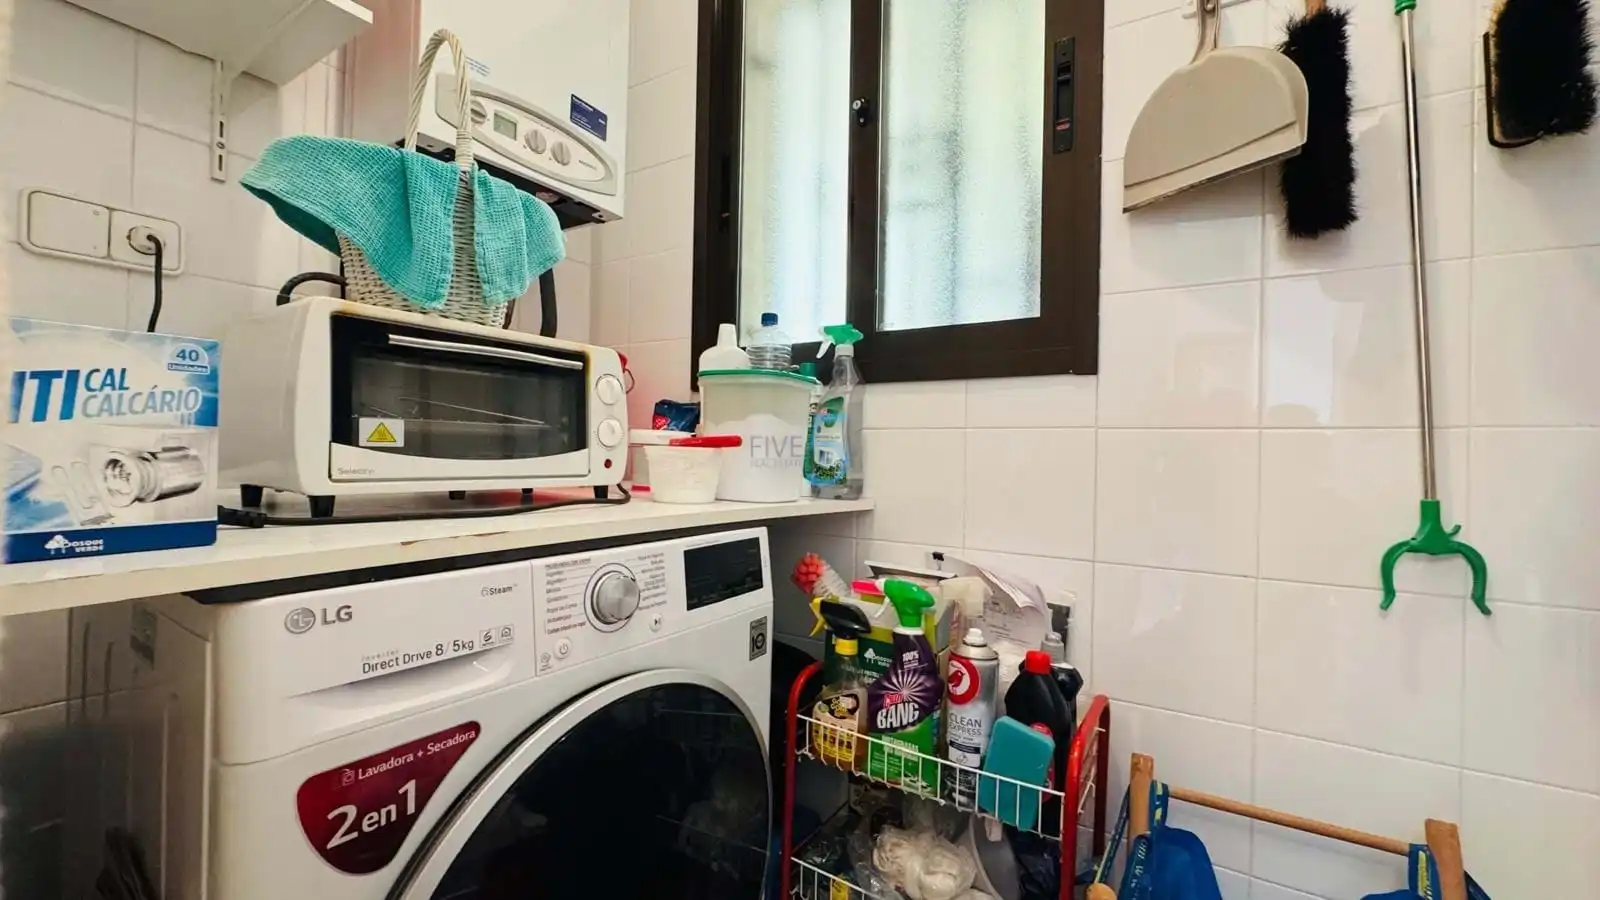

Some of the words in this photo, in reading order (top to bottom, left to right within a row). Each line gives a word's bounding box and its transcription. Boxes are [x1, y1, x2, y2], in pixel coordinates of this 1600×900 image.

[176, 349, 199, 362] 40
[84, 367, 130, 393] CAL
[81, 384, 201, 418] CALCÁRIO
[320, 605, 353, 626] LG
[362, 656, 400, 674] Direct
[403, 650, 432, 665] Drive
[876, 702, 920, 729] BANG
[949, 712, 982, 728] CLEAN
[949, 721, 982, 736] EXPRESS
[358, 752, 414, 780] Lavadora
[427, 730, 476, 755] Secadora
[326, 804, 359, 850] 2
[362, 803, 397, 833] en
[398, 779, 416, 815] 1
